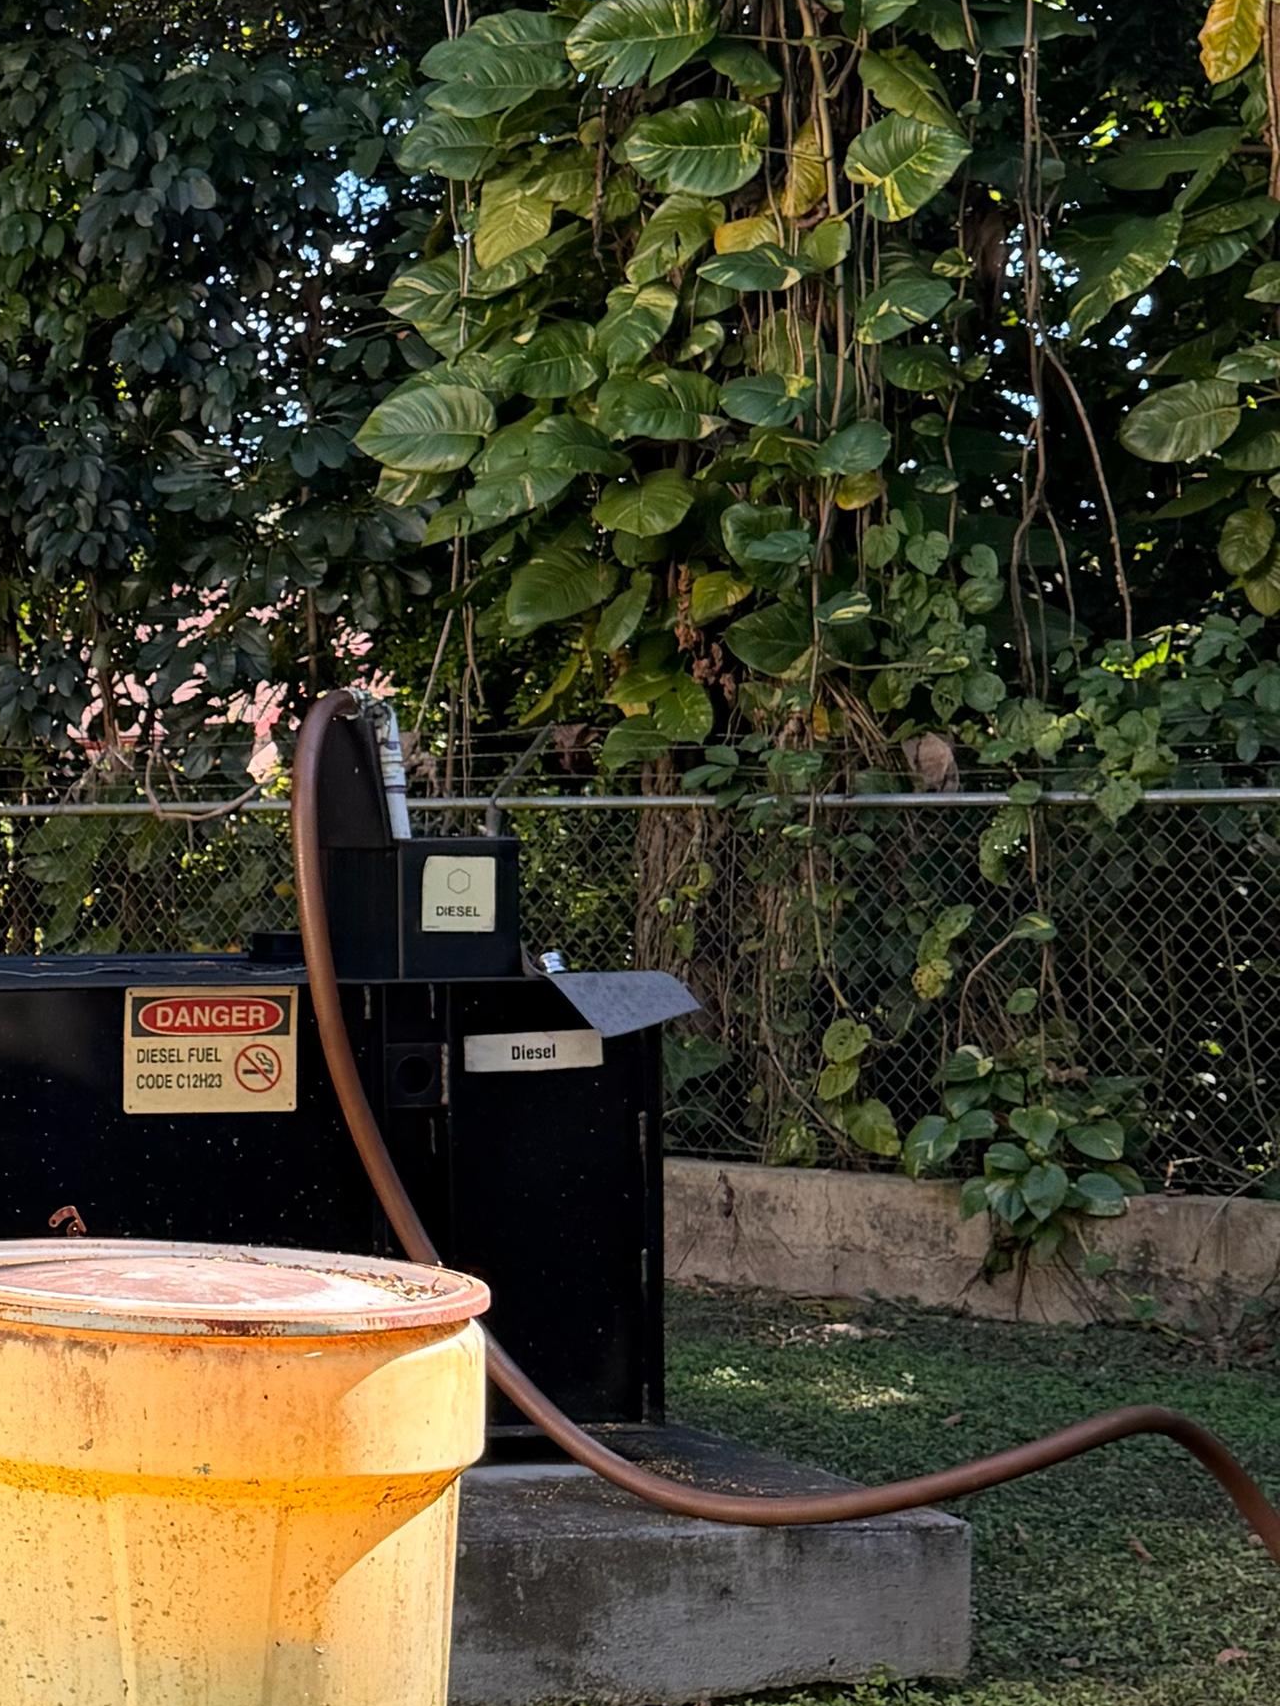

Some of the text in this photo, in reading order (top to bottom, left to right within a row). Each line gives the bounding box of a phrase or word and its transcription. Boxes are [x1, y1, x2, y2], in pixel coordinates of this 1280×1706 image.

[435, 905, 481, 917] DIESEL
[156, 1005, 266, 1027] DANGER
[136, 1048, 223, 1064] DIESEL FUEL
[511, 1043, 557, 1060] Diesel
[136, 1073, 223, 1090] CODE C12H23
